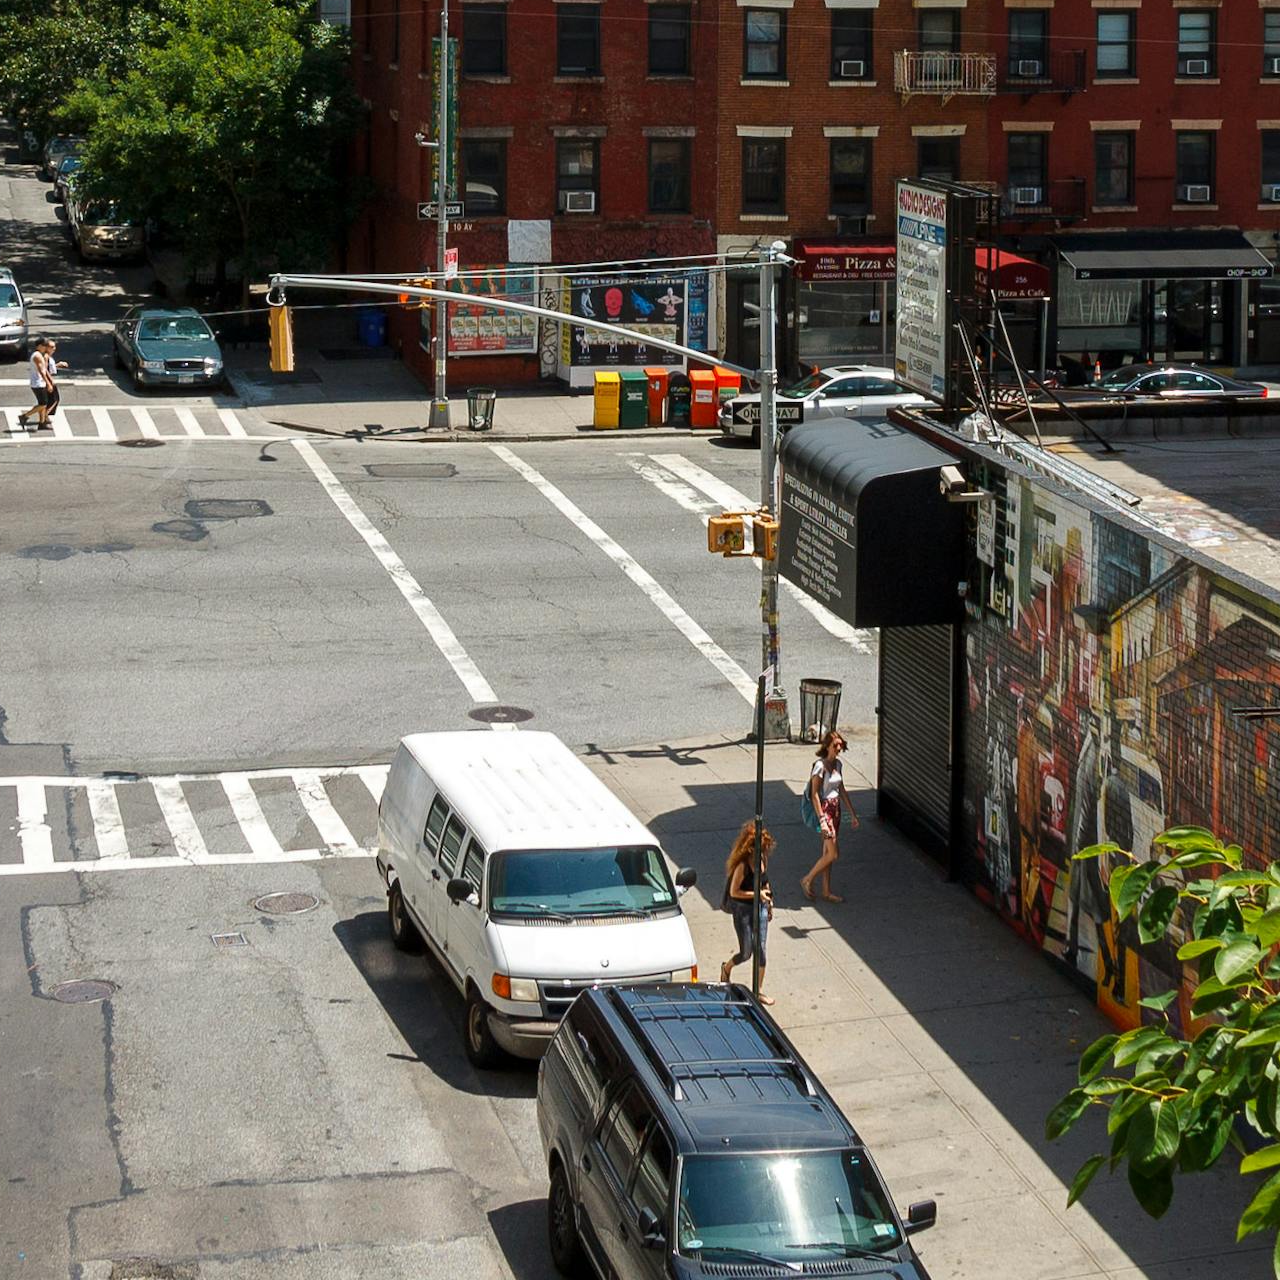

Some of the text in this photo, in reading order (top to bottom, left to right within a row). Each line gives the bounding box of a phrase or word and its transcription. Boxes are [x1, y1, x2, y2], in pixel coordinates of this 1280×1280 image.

[453, 223, 462, 231] 10
[845, 257, 881, 270] Pizza
[886, 257, 896, 269] &
[998, 289, 1017, 297] Pizza
[784, 473, 813, 498] SPECIALIZING
[826, 516, 848, 540] VEHICLES
